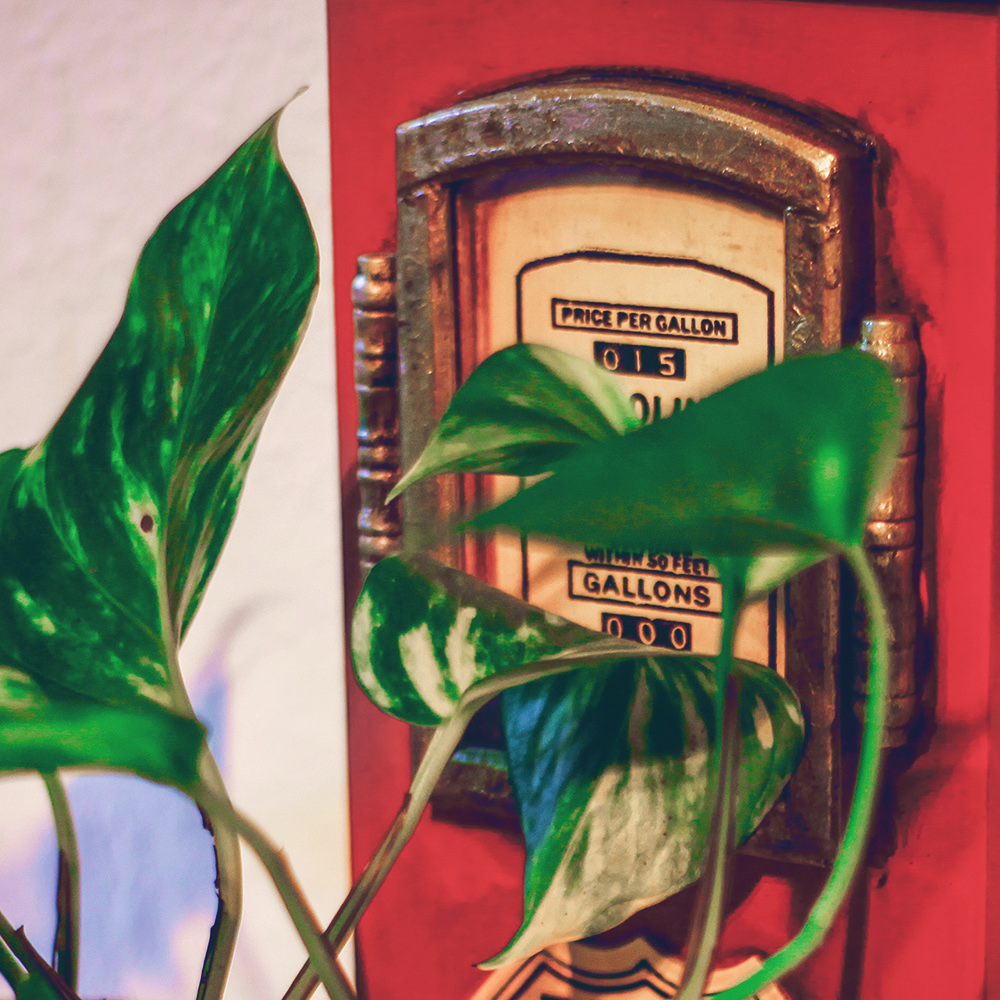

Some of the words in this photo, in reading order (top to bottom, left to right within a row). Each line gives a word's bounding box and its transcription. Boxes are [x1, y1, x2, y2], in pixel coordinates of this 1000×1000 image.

[562, 306, 613, 328] PRICE
[616, 311, 652, 331] PER
[655, 314, 727, 338] GALLON
[583, 572, 711, 608] GALLONS
